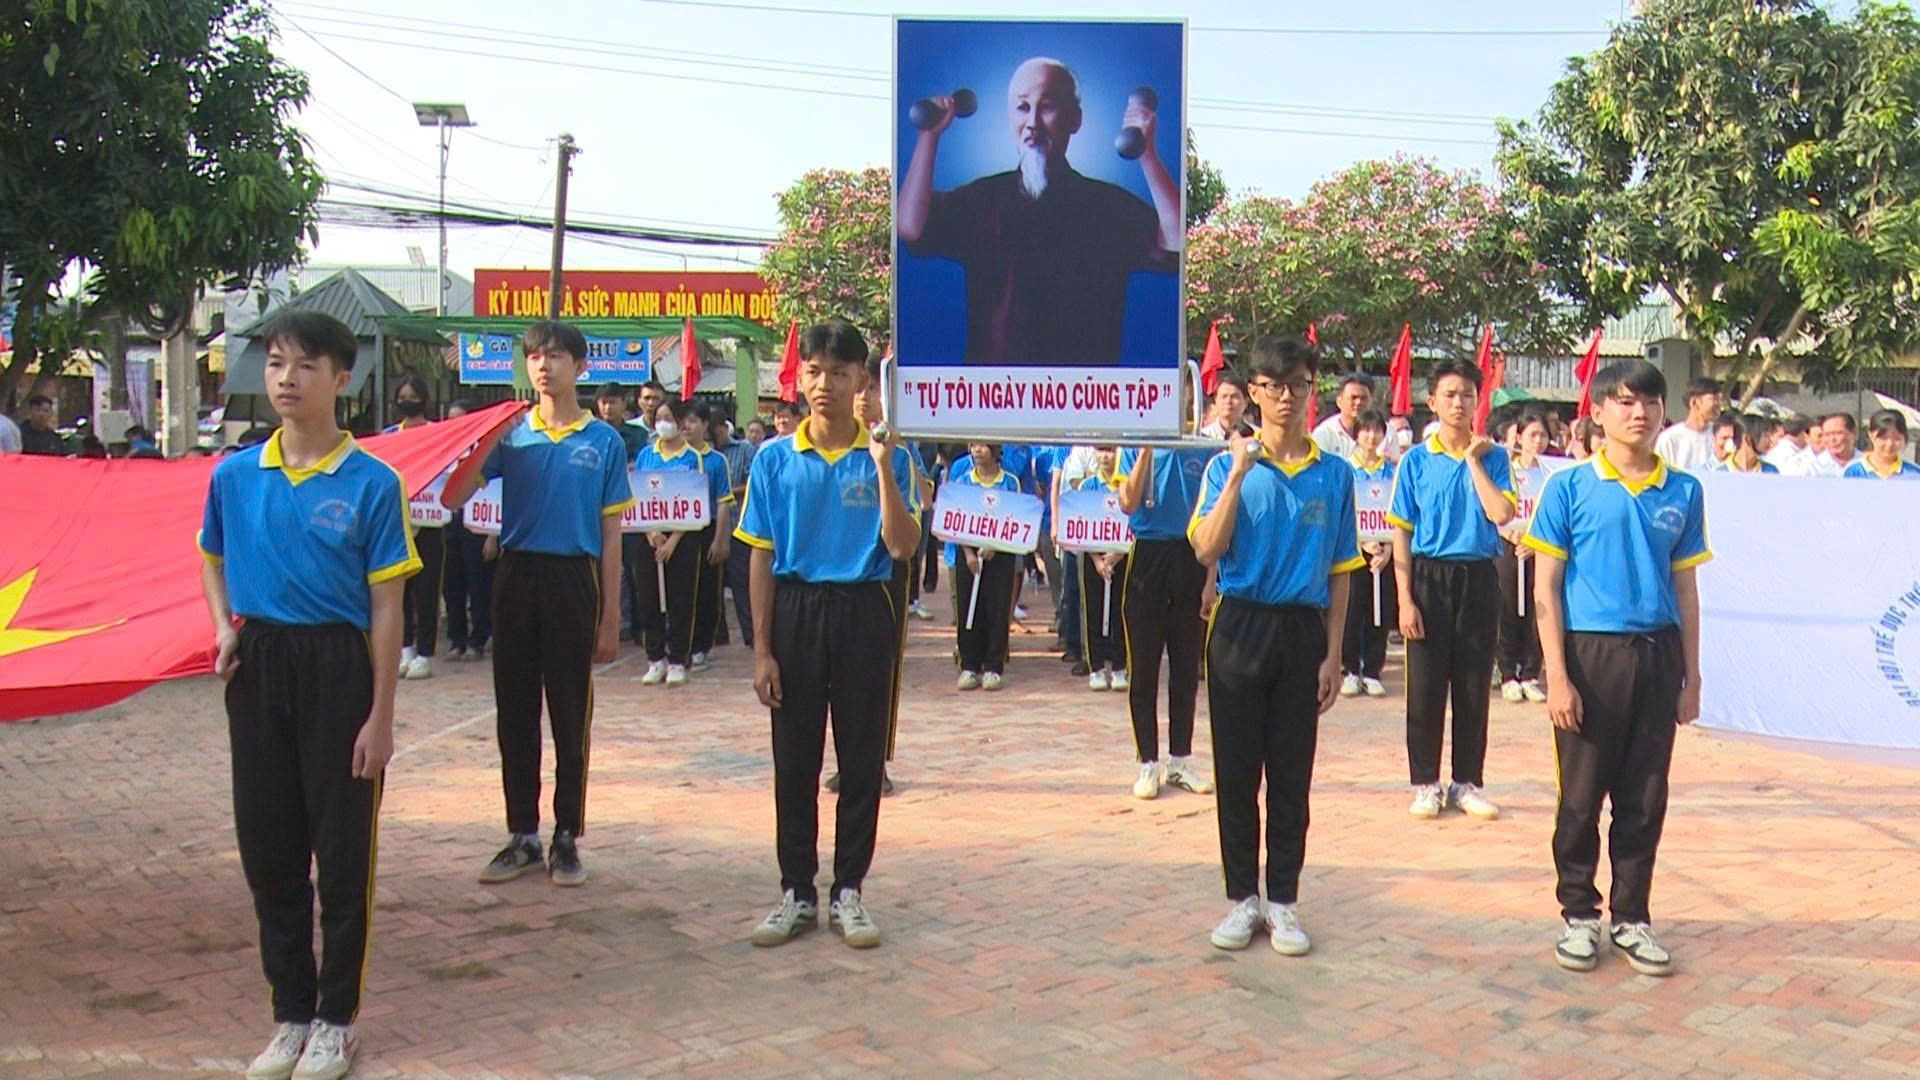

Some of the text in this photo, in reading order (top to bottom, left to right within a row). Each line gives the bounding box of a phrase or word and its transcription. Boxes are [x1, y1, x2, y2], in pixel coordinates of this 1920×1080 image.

[489, 281, 509, 316] KỶ
[559, 285, 574, 316] À
[579, 285, 609, 316] SỨC
[666, 283, 697, 316] CỦA
[945, 376, 973, 409] TÔI
[979, 375, 1026, 409] NGÀY
[1032, 375, 1067, 410] NÀO
[1072, 375, 1120, 410] CŨNG
[1126, 378, 1159, 418] TẬP
[640, 496, 669, 521] LIÊN
[673, 492, 690, 520] ẤP
[694, 499, 702, 519] 9
[943, 507, 1032, 544] ĐỘI LIÊN ẤP 7
[1066, 515, 1089, 544] ĐỘI
[1092, 517, 1121, 542] LIÊN
